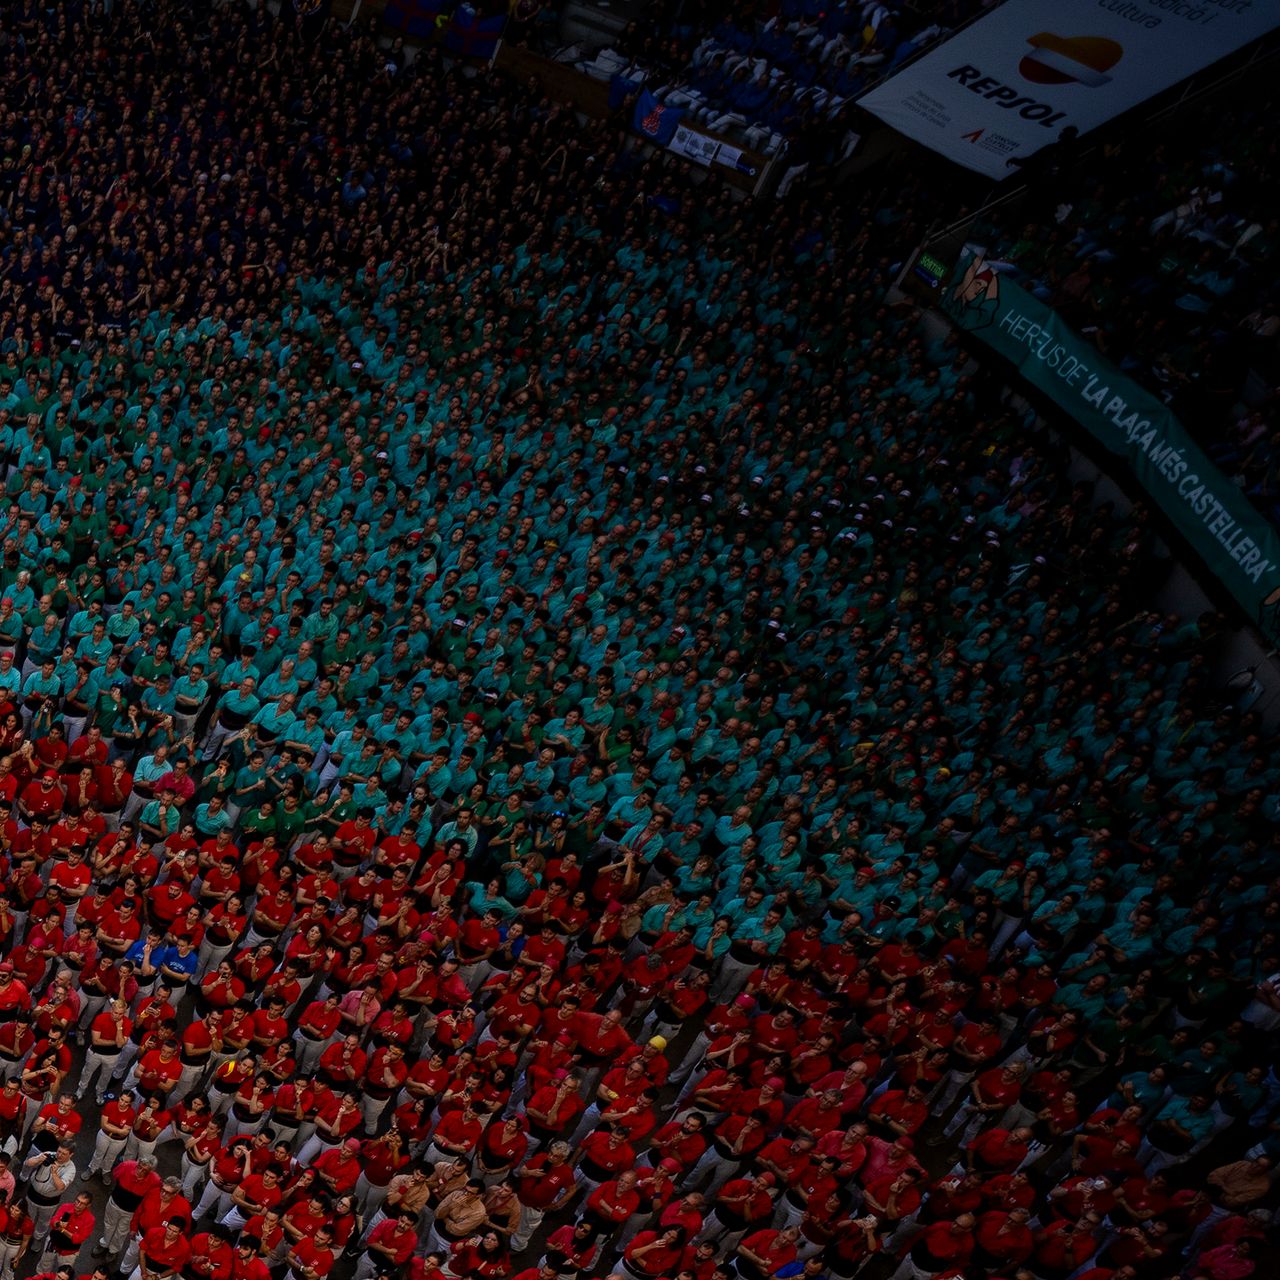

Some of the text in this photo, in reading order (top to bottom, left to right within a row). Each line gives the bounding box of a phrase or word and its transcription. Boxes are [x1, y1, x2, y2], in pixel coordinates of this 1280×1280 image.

[947, 65, 1068, 128] REPSOL
[1059, 357, 1089, 387] DE
[1103, 396, 1158, 452] PLAÇA
[1148, 446, 1189, 484] MÉS
